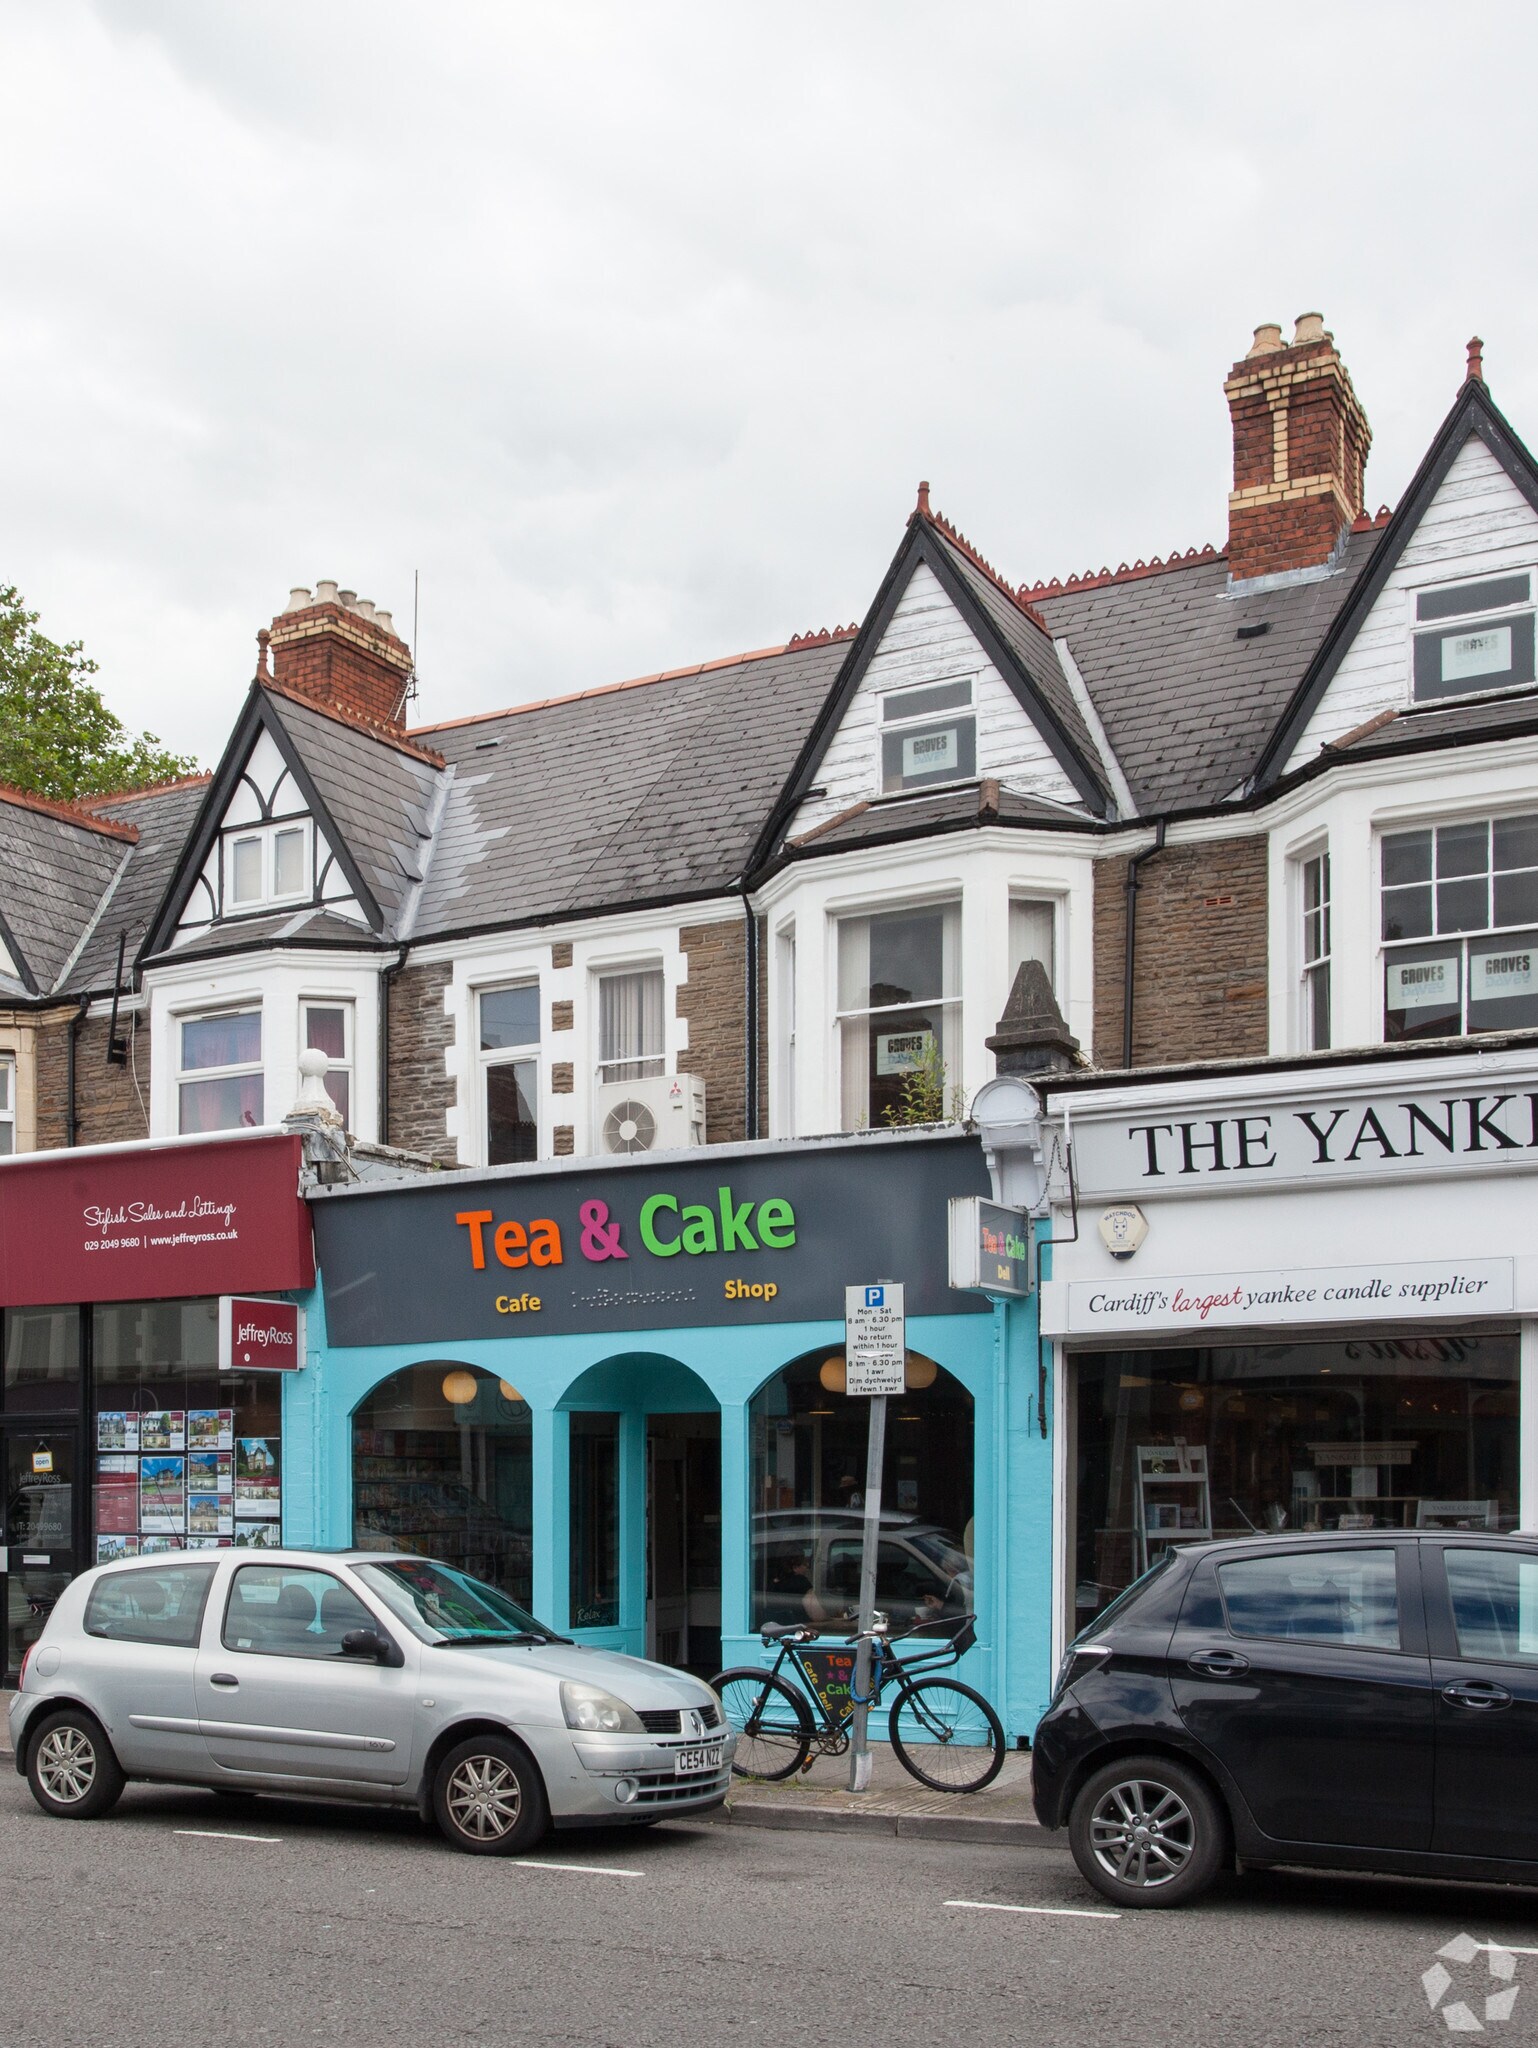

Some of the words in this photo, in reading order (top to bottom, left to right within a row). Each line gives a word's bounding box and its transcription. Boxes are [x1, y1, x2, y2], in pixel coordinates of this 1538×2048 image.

[913, 735, 947, 755] GROVES
[1401, 965, 1444, 985] GROVES
[1485, 955, 1530, 975] GROVES
[1128, 1115, 1277, 1177] THE
[83, 1206, 128, 1234] Stylish
[128, 1202, 163, 1223] Sales
[164, 1201, 187, 1219] and
[188, 1195, 237, 1226] Lettings
[1103, 1211, 1136, 1221] WATCHDOG
[456, 1210, 563, 1270] Tea
[579, 1199, 629, 1262] &
[639, 1186, 796, 1257] Cake
[84, 1241, 99, 1251] 029
[100, 1239, 120, 1250] 2049
[121, 1238, 140, 1248] 9680
[150, 1229, 238, 1247] www.jeffreyross.co.uk
[982, 1227, 998, 1254] Tea
[998, 1231, 1005, 1256] &
[1006, 1233, 1026, 1261] Cake
[997, 1264, 1011, 1280] Deli
[495, 1293, 541, 1313] Cafe
[724, 1279, 778, 1301] Shop
[868, 1289, 880, 1305] P
[1089, 1291, 1169, 1315] Cardiff's
[1171, 1286, 1243, 1319] largest
[1243, 1284, 1317, 1310] yankee
[1323, 1279, 1392, 1301] candle
[1398, 1275, 1489, 1302] supplier
[880, 1307, 892, 1315] Sat
[236, 1323, 293, 1347] JeffreyRoss
[870, 1333, 893, 1341] return
[891, 1359, 903, 1367] pm
[864, 1376, 902, 1385] dychwelyd
[826, 1655, 852, 1667] Tea
[803, 1661, 819, 1685] Cafe
[838, 1670, 848, 1681] &
[826, 1683, 851, 1695] Cak
[818, 1691, 834, 1711] Deli
[839, 1700, 855, 1717] Caf
[680, 1750, 705, 1770] CE54
[706, 1747, 720, 1767] NZZ
